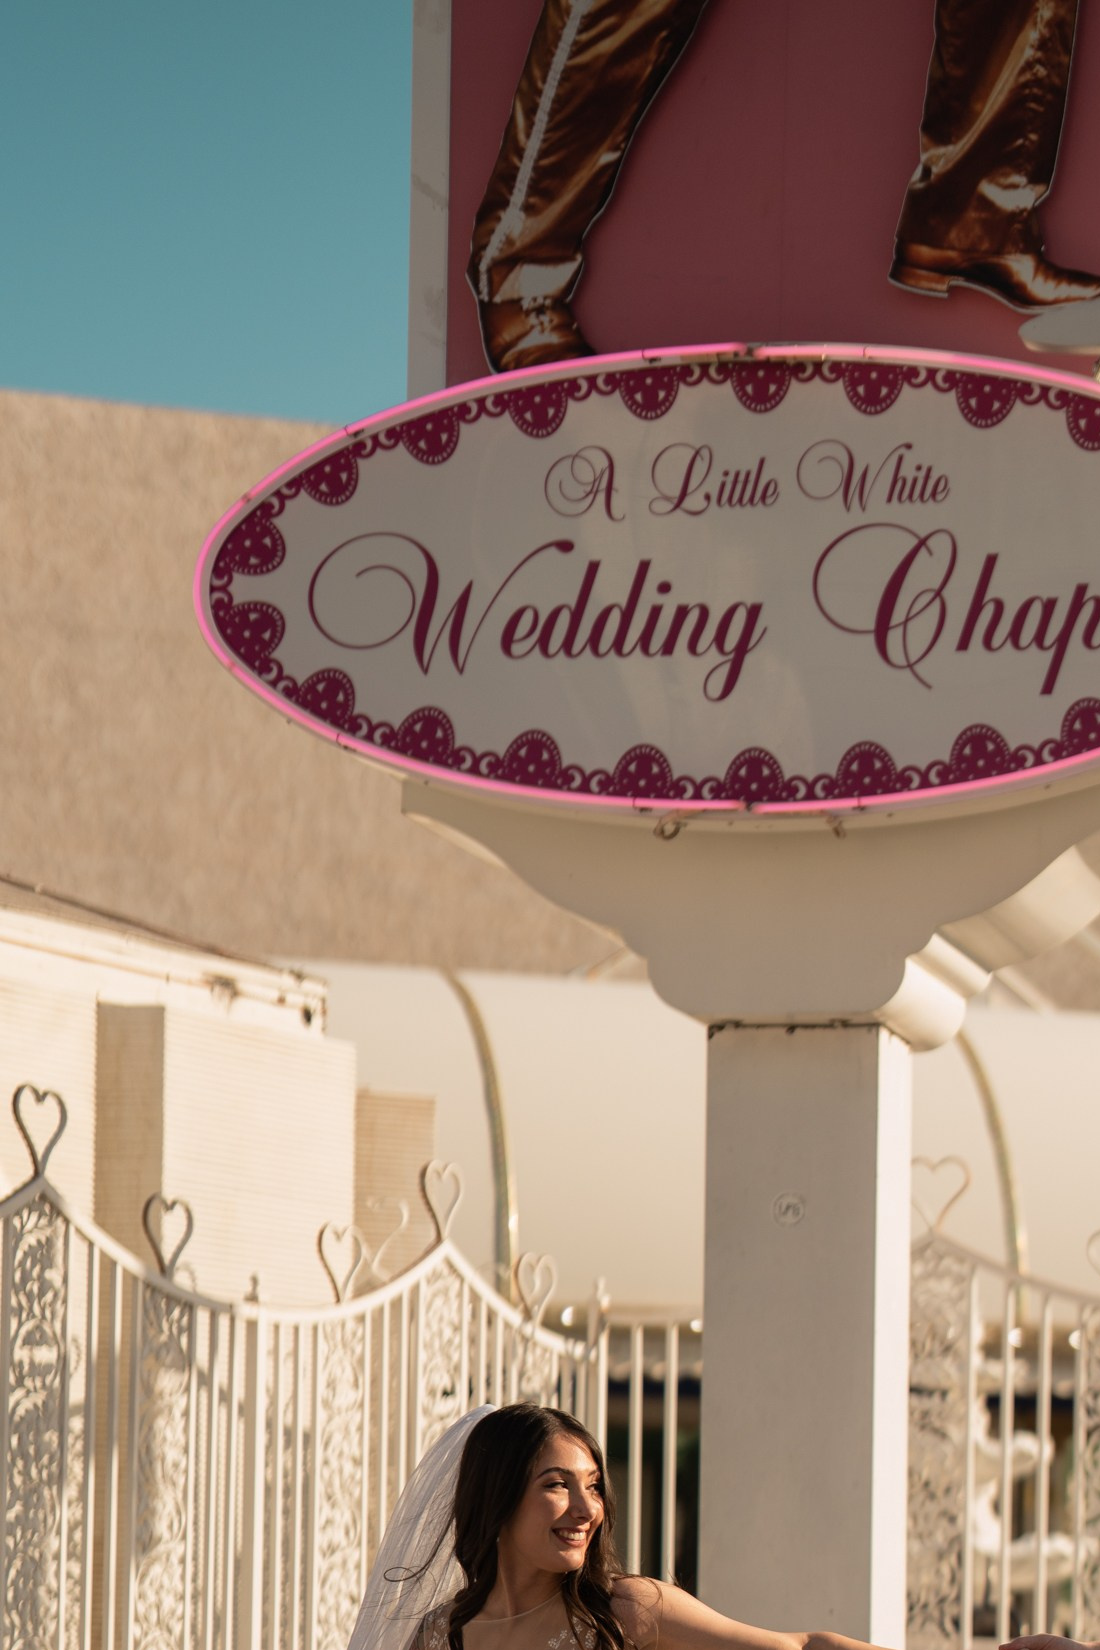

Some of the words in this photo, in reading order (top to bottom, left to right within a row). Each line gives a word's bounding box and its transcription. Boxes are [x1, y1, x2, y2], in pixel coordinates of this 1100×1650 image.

[544, 445, 626, 522] A
[649, 442, 780, 516] Little
[796, 439, 951, 513] White
[308, 531, 768, 702] Wedding
